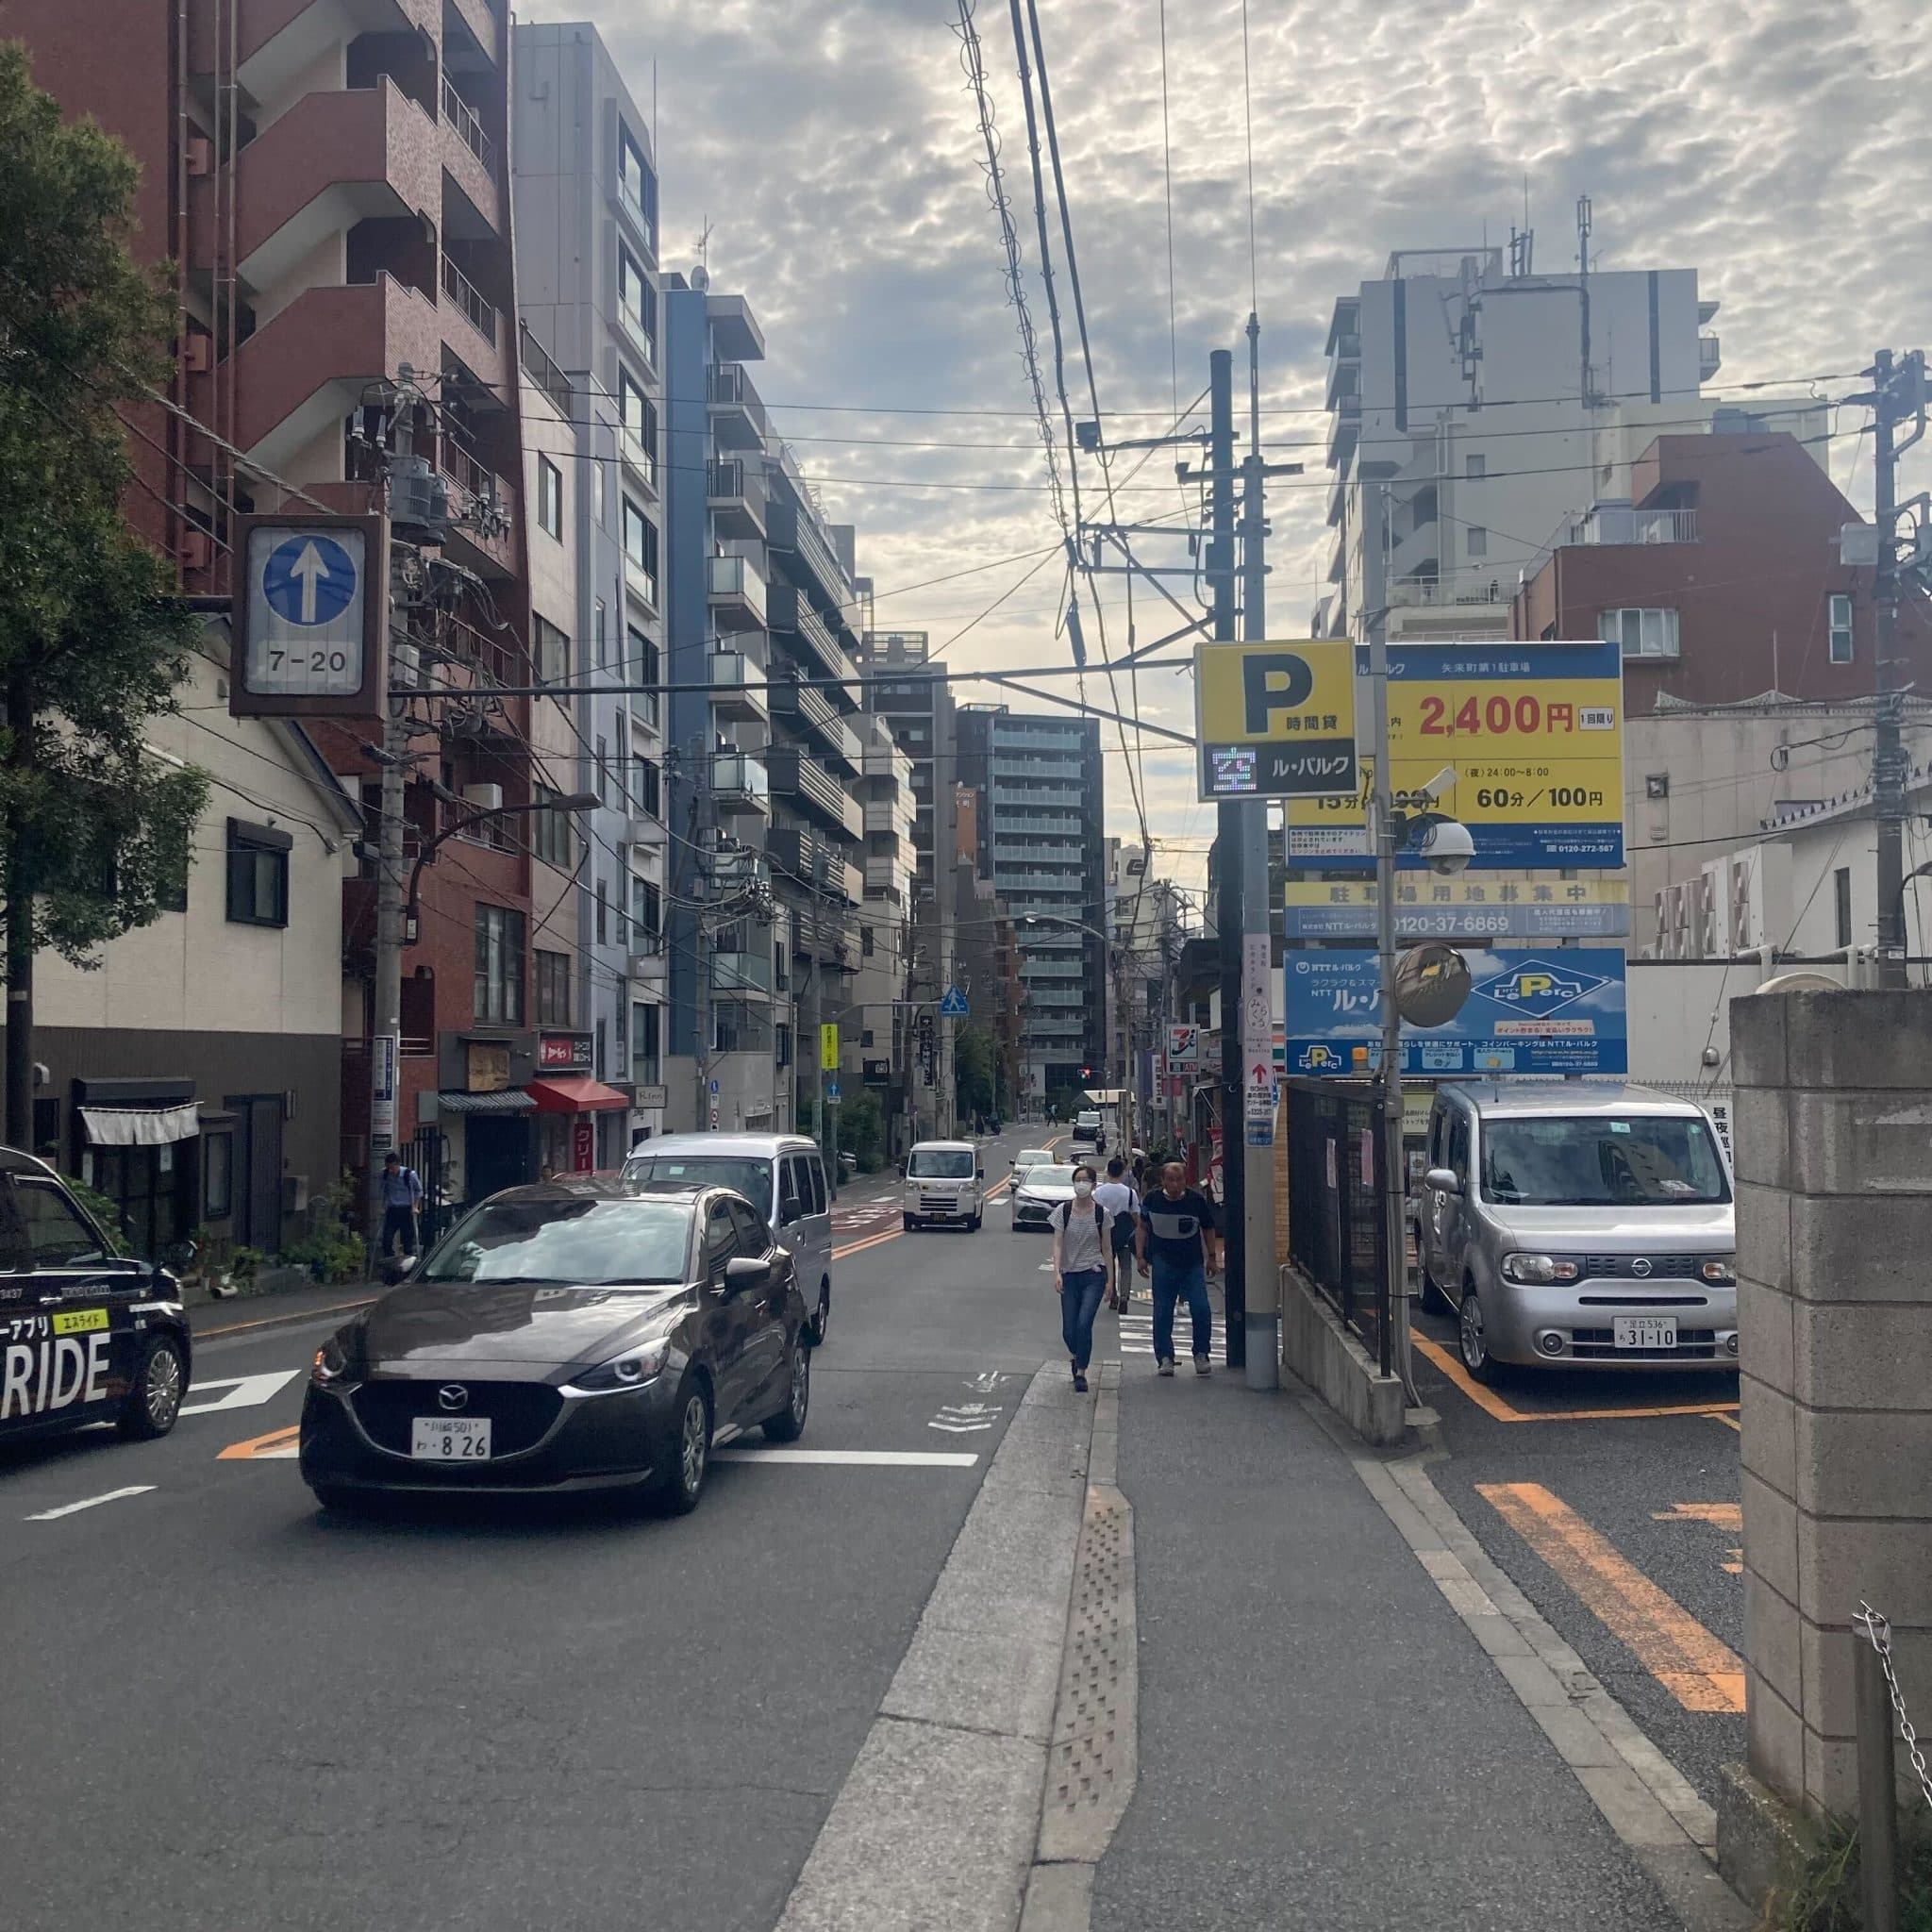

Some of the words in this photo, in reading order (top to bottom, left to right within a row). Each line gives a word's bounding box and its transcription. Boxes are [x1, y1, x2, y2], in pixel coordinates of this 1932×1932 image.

[1242, 654, 1313, 734] P
[1286, 715, 1338, 731] 時間貸
[1212, 747, 1257, 791] 空
[1628, 1330, 1674, 1345] 31-10
[0, 1332, 111, 1419] RIDE
